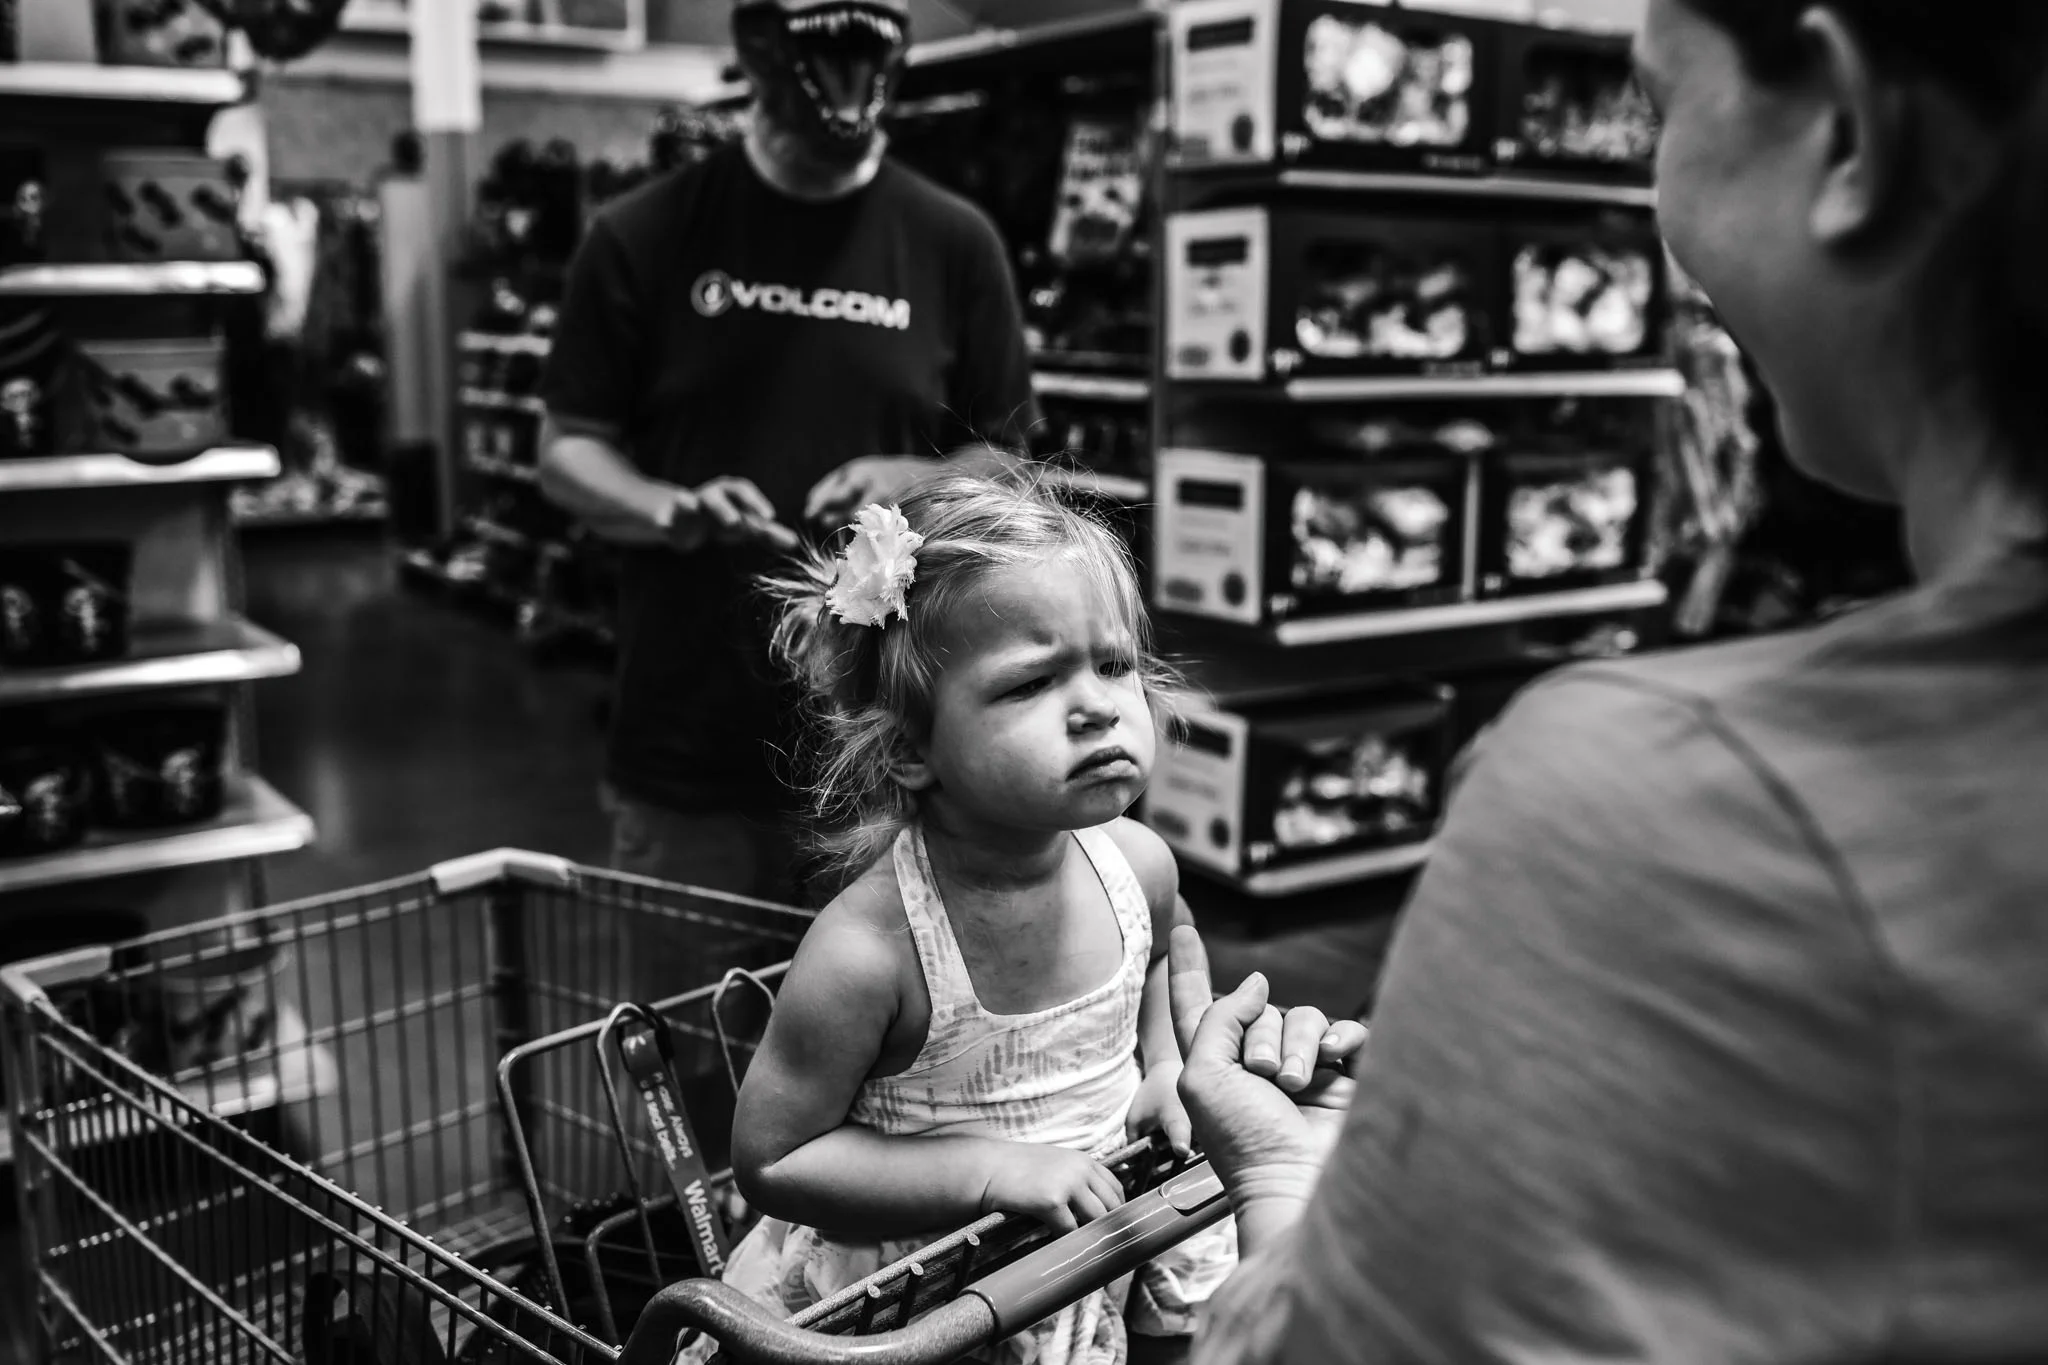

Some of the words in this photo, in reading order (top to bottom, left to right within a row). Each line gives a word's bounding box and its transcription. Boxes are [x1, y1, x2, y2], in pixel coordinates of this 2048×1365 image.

[731, 281, 911, 330] VOLCOM
[640, 1080, 654, 1101] ue
[647, 1101, 666, 1130] seat
[668, 1115, 694, 1158] Always
[684, 1179, 726, 1276] Walmart
